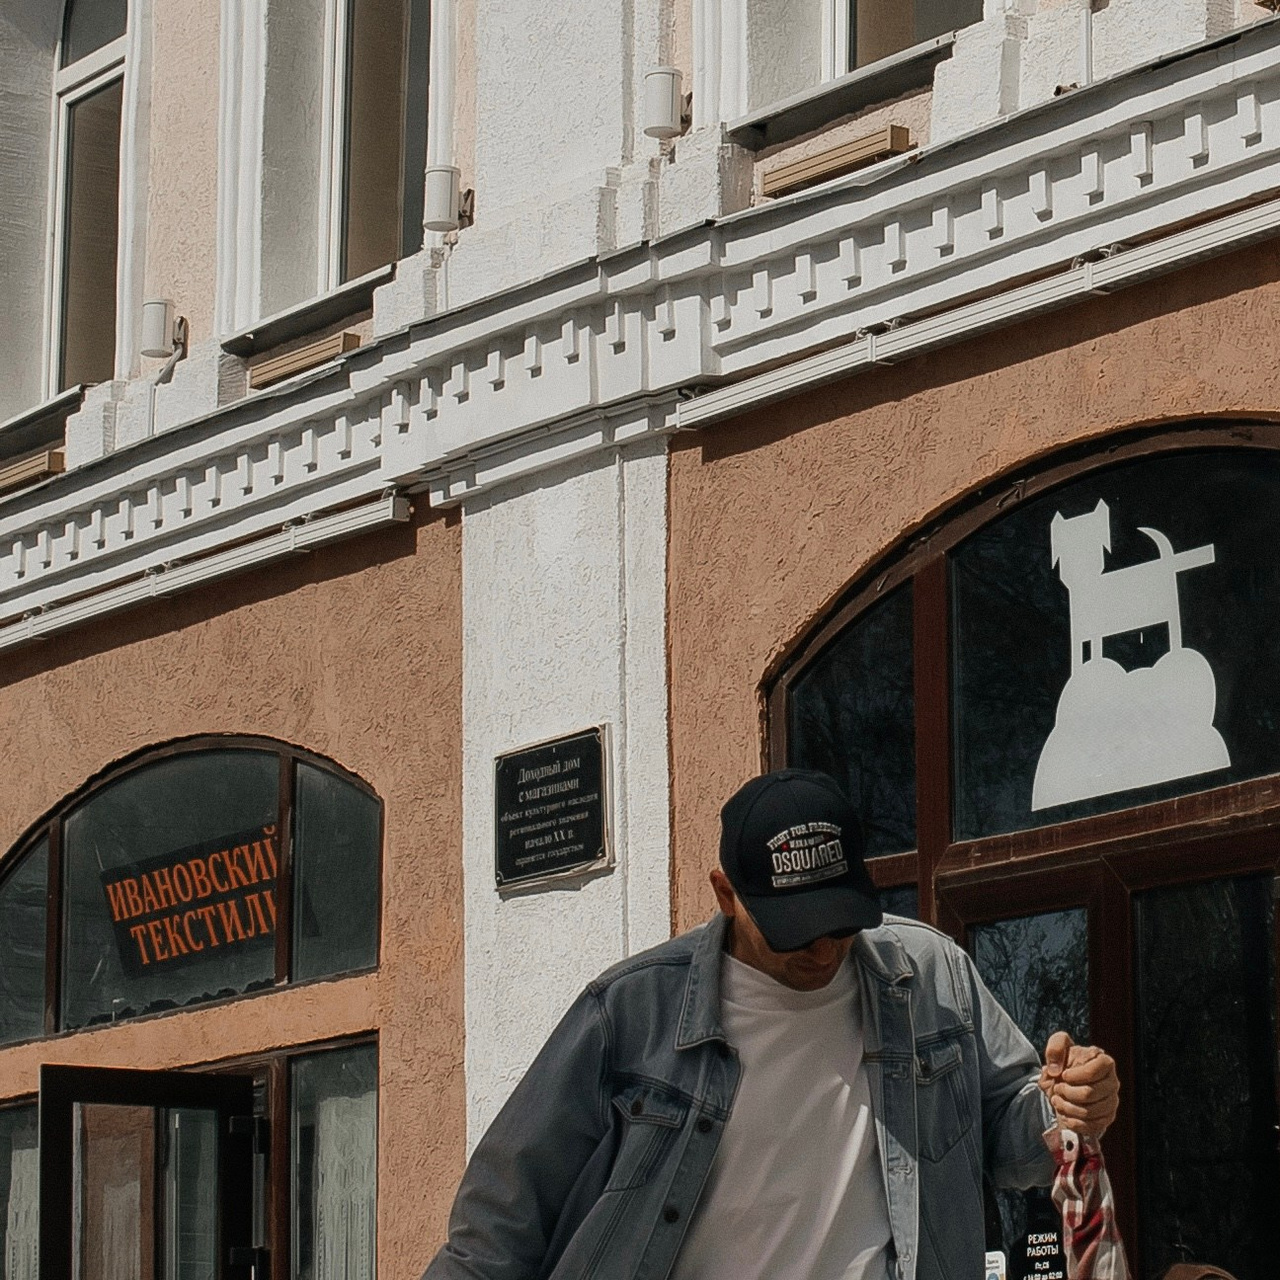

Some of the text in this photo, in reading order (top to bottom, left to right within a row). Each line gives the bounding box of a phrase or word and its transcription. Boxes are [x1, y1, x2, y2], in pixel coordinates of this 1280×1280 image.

[563, 758, 580, 772] дом
[525, 778, 579, 800] магазинами
[772, 839, 843, 873] DSQUARED
[1028, 1232, 1057, 1245] РЕЖИМ
[1026, 1244, 1059, 1257] РАБОТЫ
